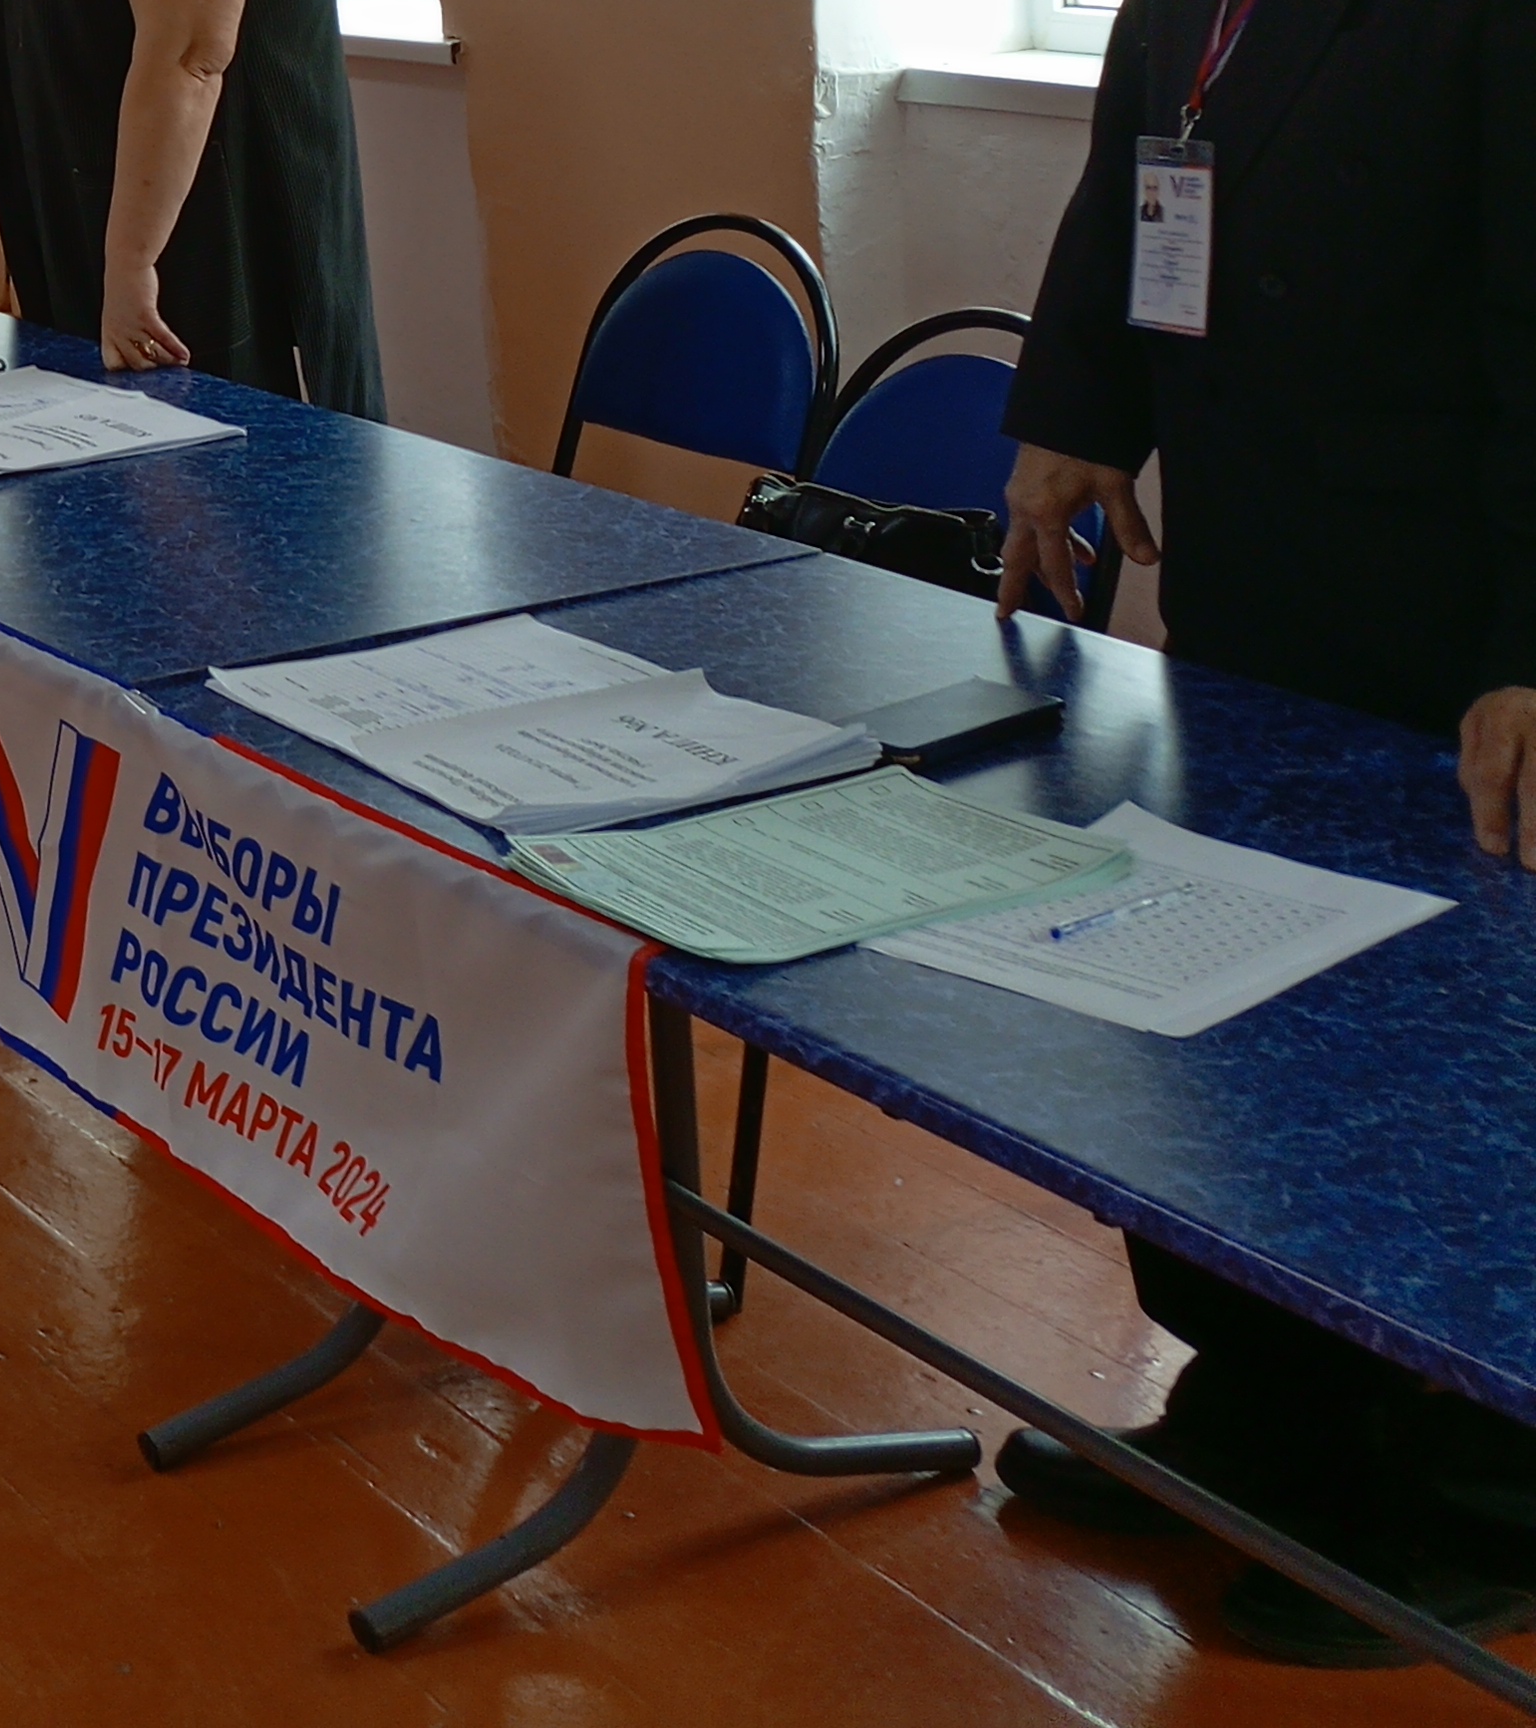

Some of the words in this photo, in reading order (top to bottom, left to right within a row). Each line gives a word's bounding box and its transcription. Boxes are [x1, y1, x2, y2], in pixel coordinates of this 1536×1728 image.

[143, 770, 341, 946] ВЫБОРЫ
[110, 926, 310, 1088] РОССИИ
[125, 856, 444, 1083] ПРЕЗИДЕНТА
[184, 1057, 321, 1169] МАРТА
[317, 1139, 390, 1239] 2024
